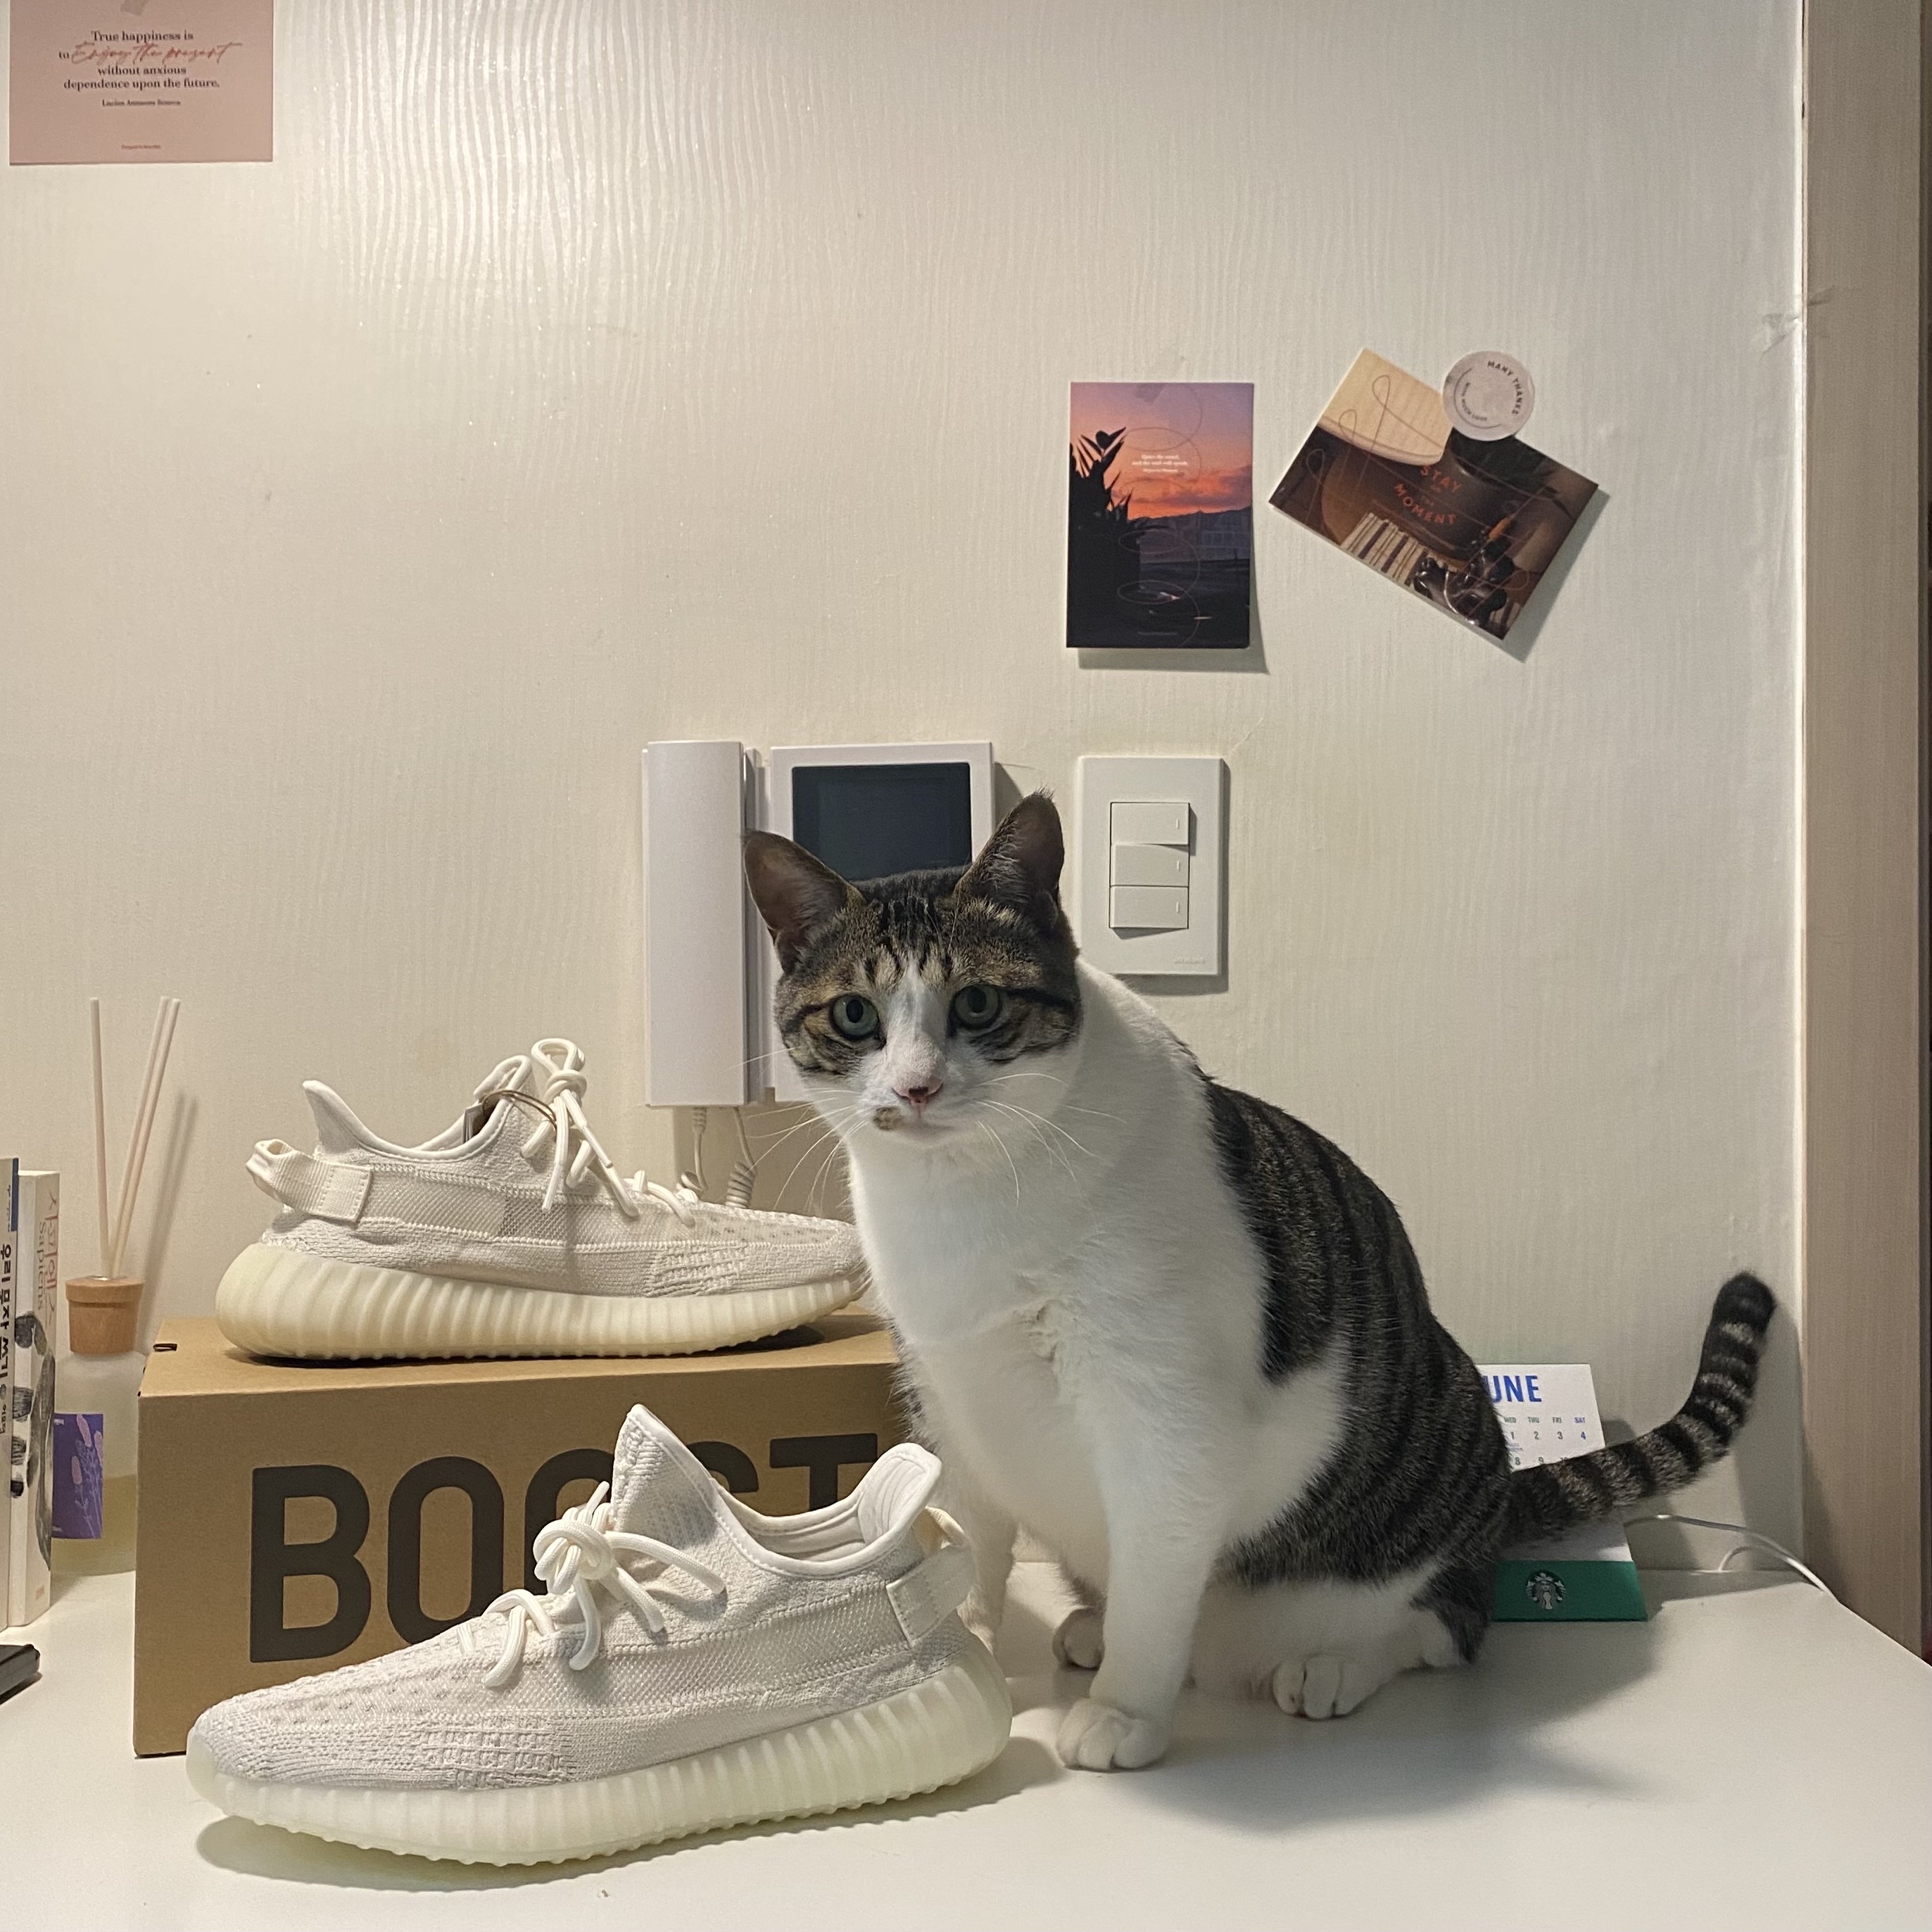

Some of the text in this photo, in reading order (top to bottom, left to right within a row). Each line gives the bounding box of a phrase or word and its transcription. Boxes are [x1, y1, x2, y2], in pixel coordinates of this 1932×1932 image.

[91, 30, 194, 44] True happiness is
[59, 51, 70, 59] to
[163, 42, 243, 64] present
[98, 64, 187, 75] without anxious
[64, 77, 220, 91] dependence upon the future.
[1487, 360, 1523, 415] MANY THANKS
[1420, 465, 1461, 492] STAY
[1394, 483, 1457, 524] MOMENT
[0, 1244, 11, 1282] 우리
[37, 1221, 46, 1311] Sapiens
[44, 1188, 58, 1330] 사피엔스
[1481, 1375, 1542, 1403] UNE
[1510, 1431, 1586, 1440] 1 2 3 4
[1515, 1456, 1521, 1465] 8
